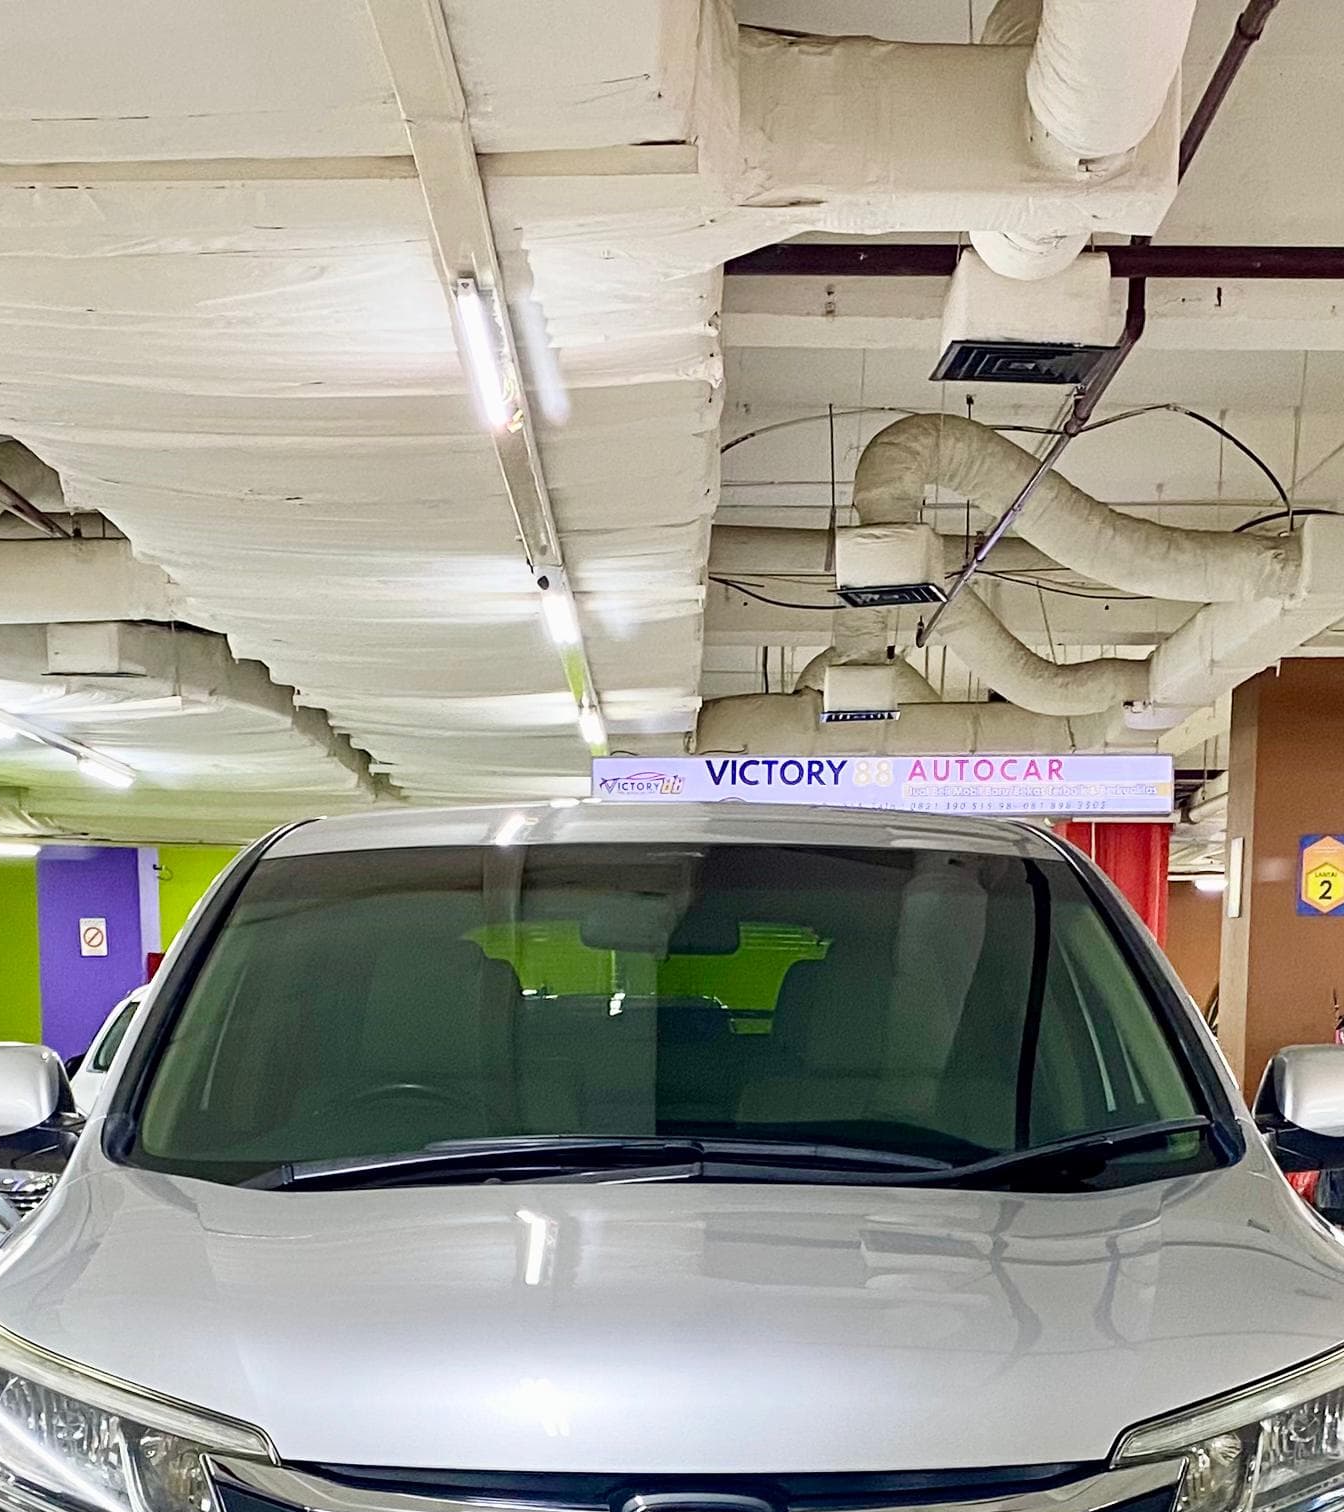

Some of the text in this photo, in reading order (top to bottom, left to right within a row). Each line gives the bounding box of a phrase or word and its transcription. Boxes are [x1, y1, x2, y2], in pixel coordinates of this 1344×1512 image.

[706, 759, 1065, 786] VICTORY 88 AUTOCAR
[602, 780, 660, 795] VICTORY
[1318, 879, 1332, 900] 2
